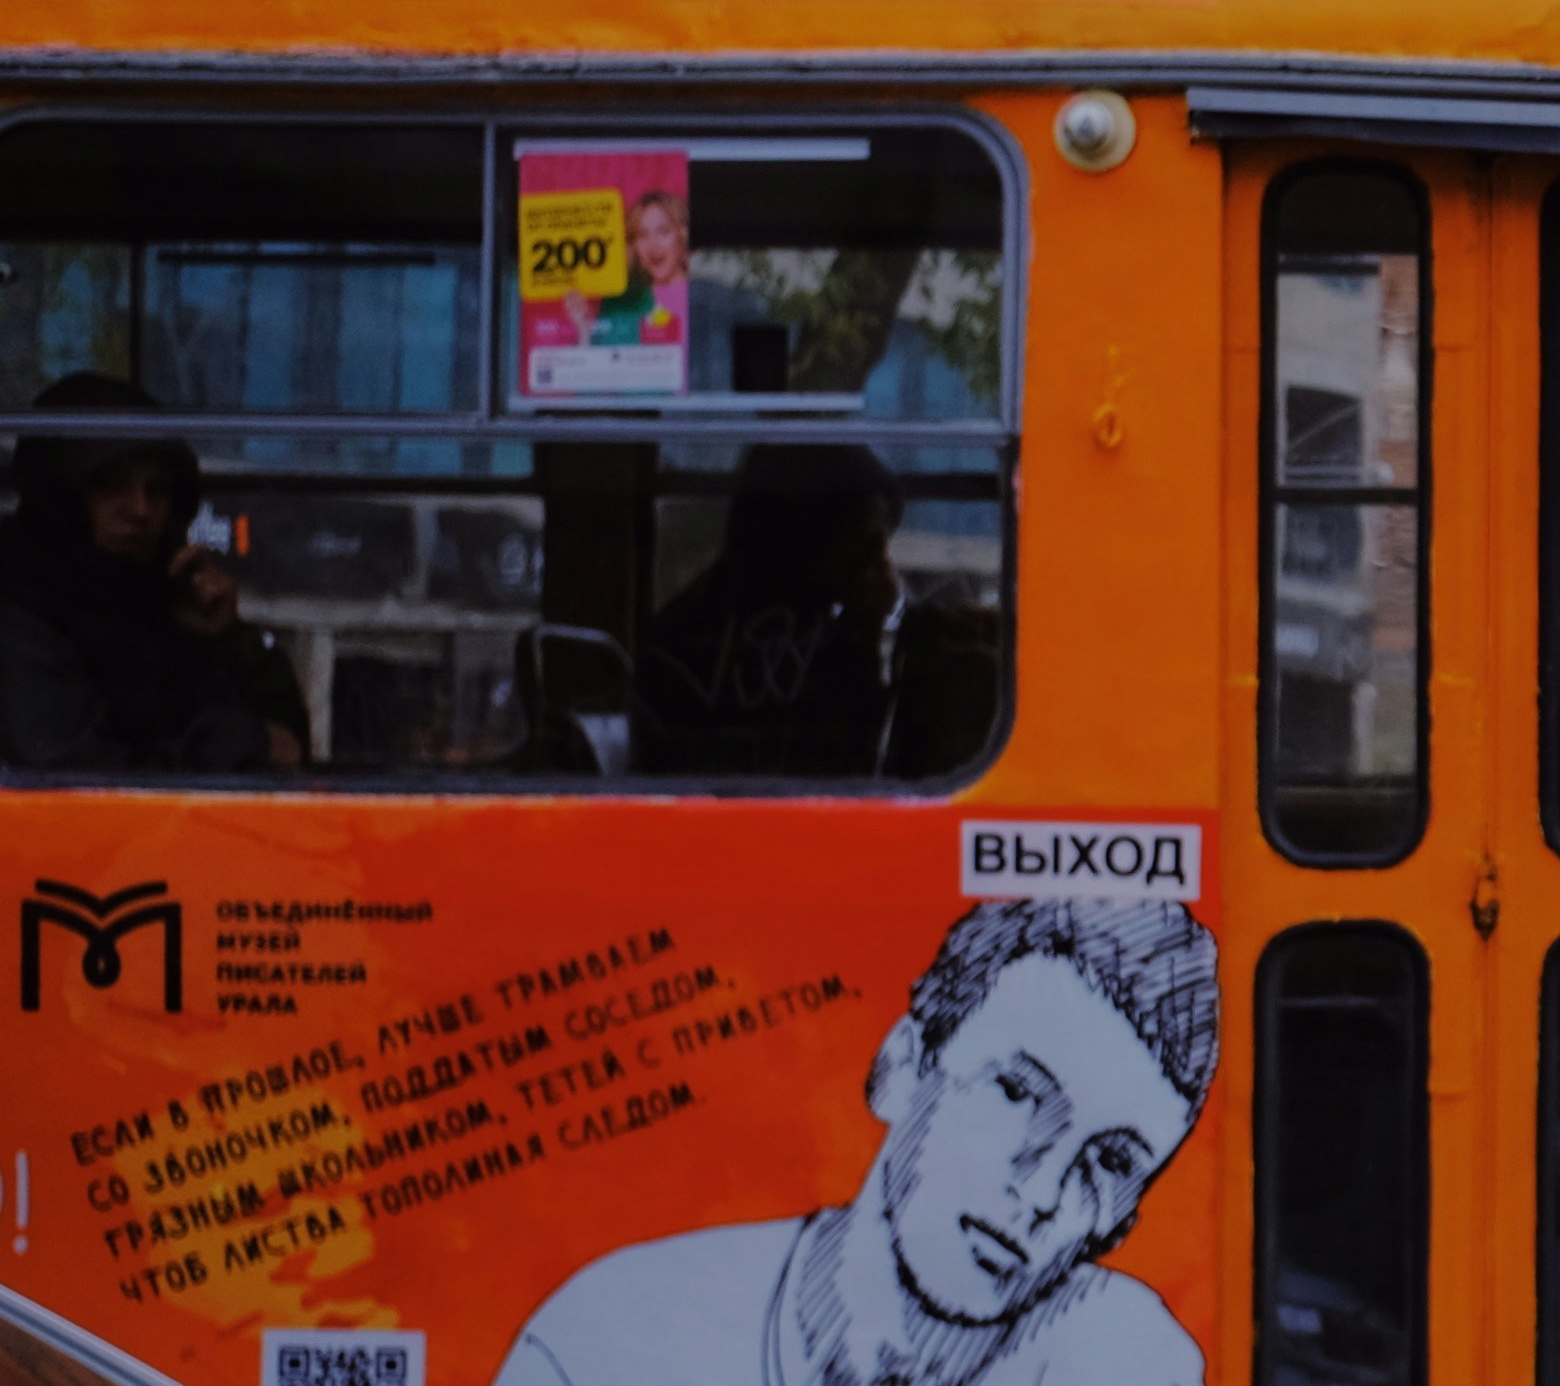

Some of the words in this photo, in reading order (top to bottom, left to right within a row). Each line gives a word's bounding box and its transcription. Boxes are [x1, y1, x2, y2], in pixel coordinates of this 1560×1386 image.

[973, 833, 1184, 886] ВЫХОД
[216, 900, 433, 923] ОБЪЕДИНЁННЫЙ
[216, 931, 300, 951] МУЗЕЙ
[216, 962, 367, 984] ПИСАТЕЛЕЙ
[217, 994, 297, 1013] УРАЛА
[71, 1109, 154, 1166] ЕСЛИ
[168, 1098, 189, 1132] В
[379, 995, 484, 1056] ЛУЧШЕ
[495, 927, 675, 1008] ТРАМВАЕМ
[87, 1174, 130, 1212] СО
[361, 1024, 552, 1115] ПОДДАТЫМ
[105, 1183, 264, 1261] ГРЯЗНЫМ
[518, 1047, 624, 1110] ТЕТЕЙ
[637, 1040, 660, 1068] С
[120, 1251, 207, 1303] ЧТОБ
[224, 1206, 346, 1273] ЛИСТВА
[360, 1133, 545, 1220] ТОПОЛИНАЯ
